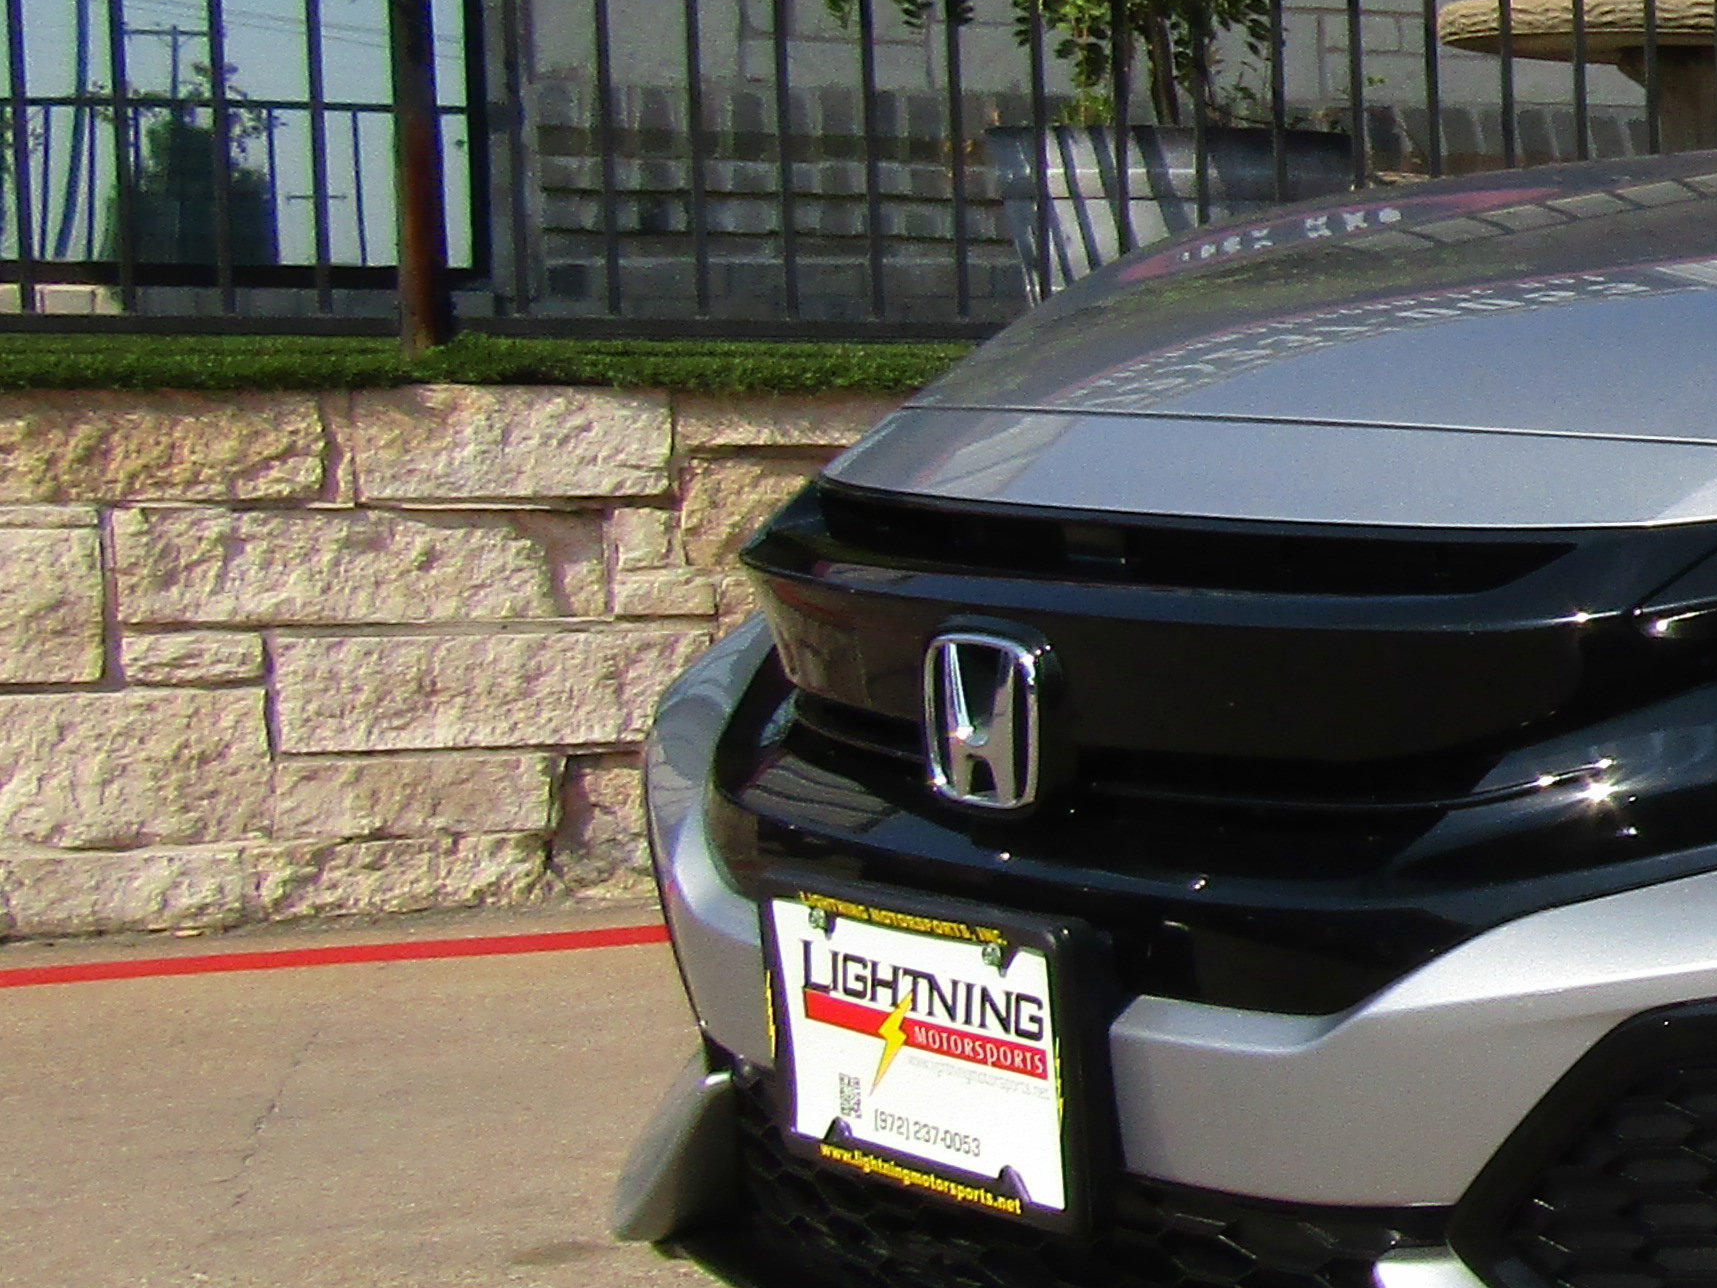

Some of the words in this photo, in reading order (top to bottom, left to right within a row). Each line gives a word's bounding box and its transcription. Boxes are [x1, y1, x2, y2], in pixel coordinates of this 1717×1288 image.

[801, 939, 1044, 1043] LIGHTNING
[912, 1025, 1045, 1074] MOTORSPORTS
[819, 1142, 1022, 1215] www.lightningmotorsports.net
